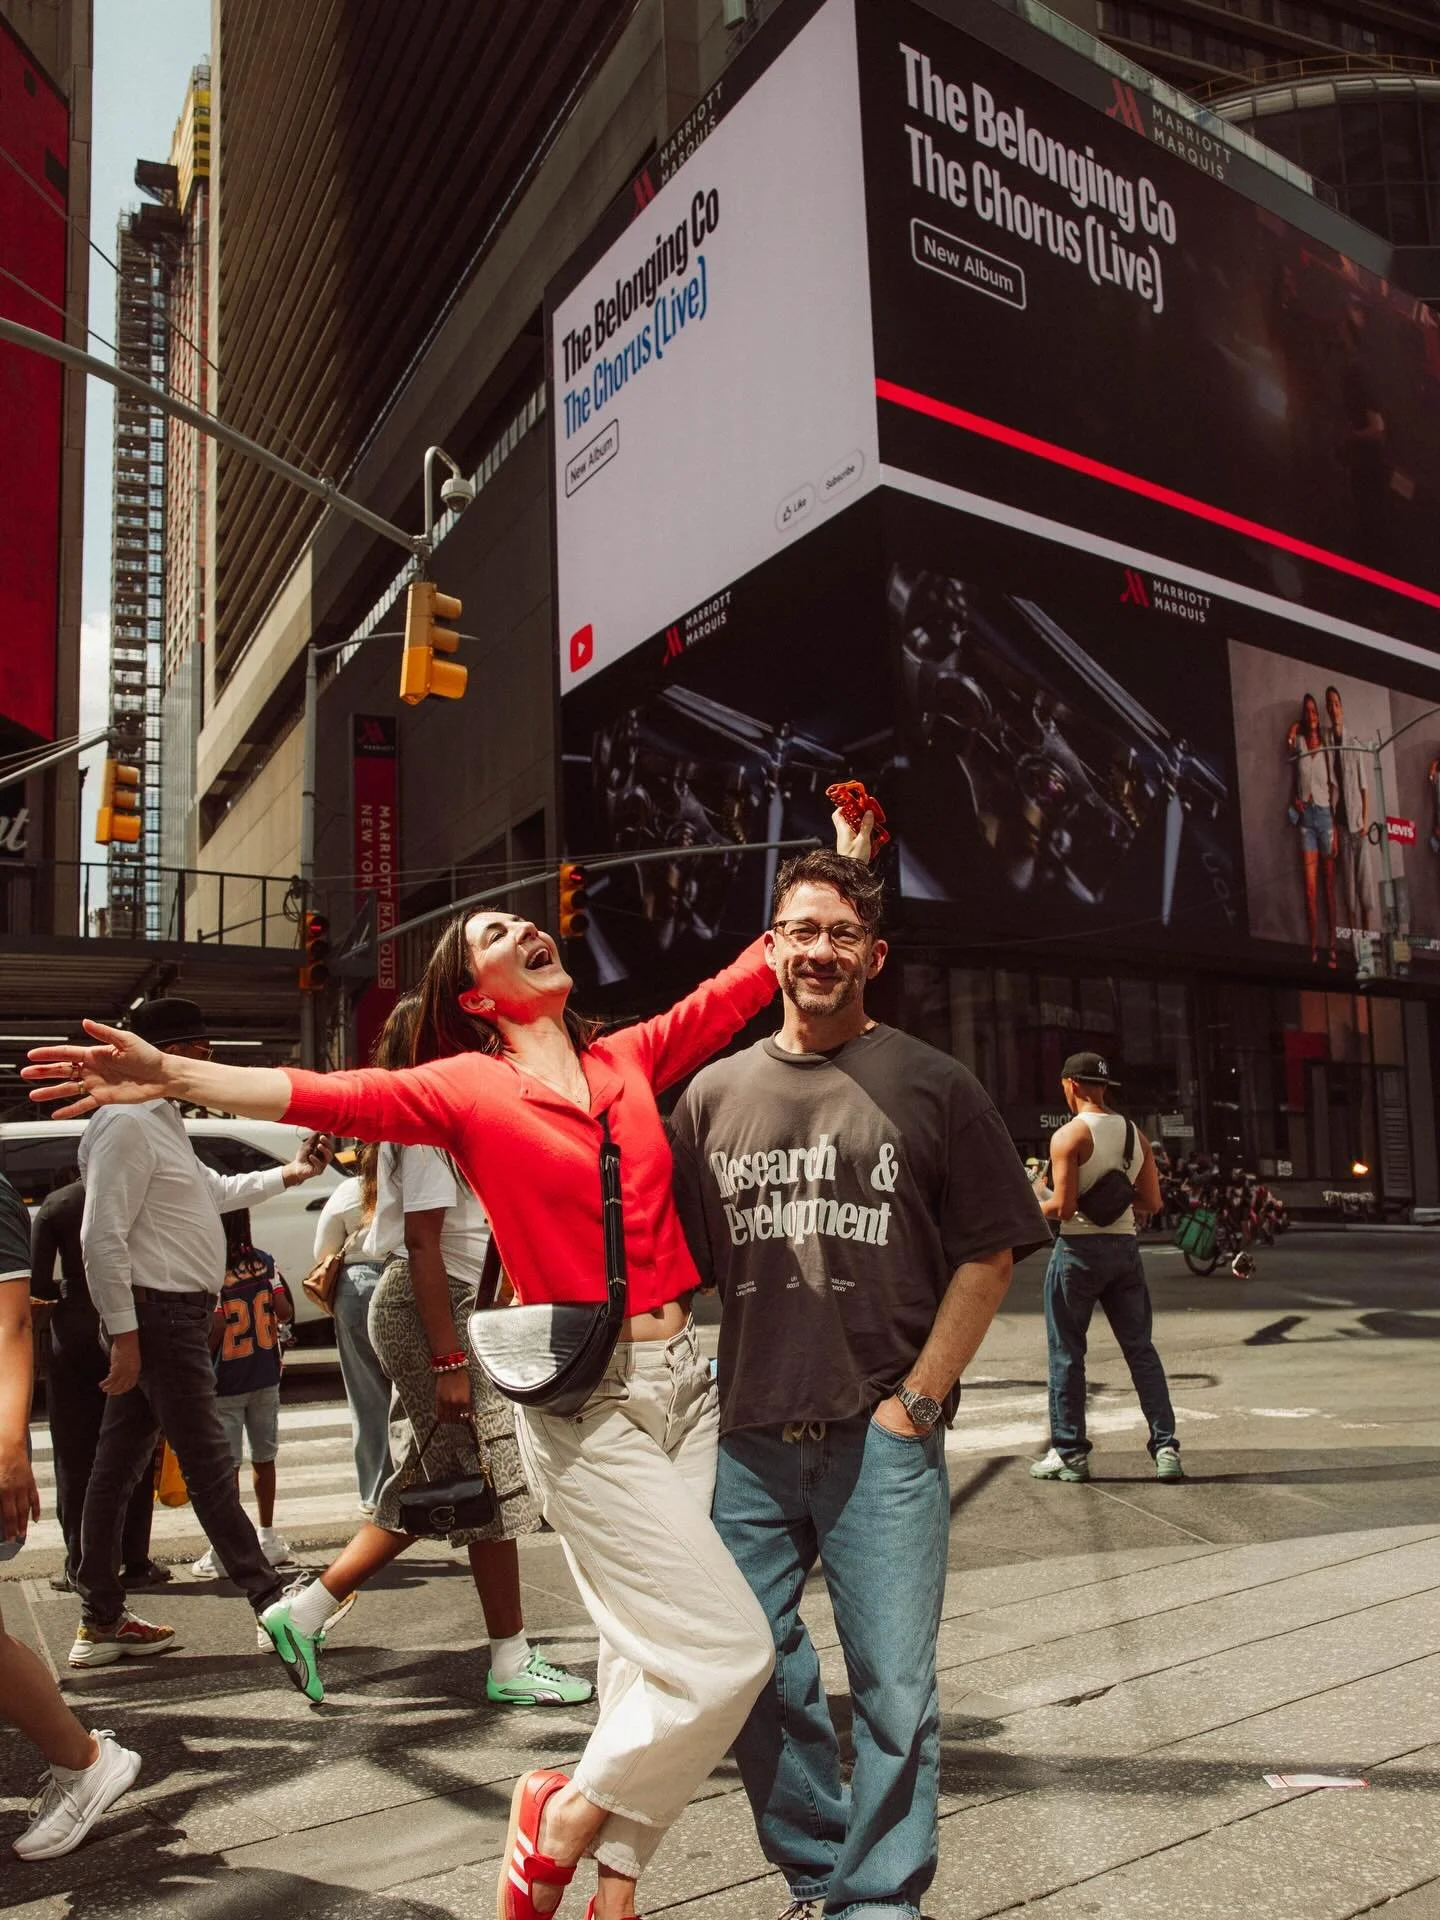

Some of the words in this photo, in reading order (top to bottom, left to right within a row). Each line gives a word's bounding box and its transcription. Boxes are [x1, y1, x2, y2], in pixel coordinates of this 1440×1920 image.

[660, 81, 722, 167] MARRIOTT
[899, 42, 968, 133] The
[972, 82, 1136, 234] Belonging
[1138, 176, 1177, 245] Co
[1152, 104, 1231, 164] MARRIOTT
[1154, 127, 1225, 181] MARQUIS
[904, 123, 967, 208] The
[972, 160, 1082, 264] Chorus
[1085, 215, 1164, 314] (Live)
[562, 324, 592, 384] The
[594, 234, 689, 352] Belonging
[691, 188, 719, 248] Co
[923, 235, 961, 268] New
[963, 254, 1015, 293] Album
[563, 389, 592, 440] The
[593, 324, 652, 412] Chorus
[654, 255, 708, 360] (Live)
[569, 462, 588, 484] New
[588, 437, 614, 466] Album
[825, 464, 856, 490] Subscribe
[793, 497, 807, 513] Like
[685, 591, 732, 631] MARRIOTT
[1153, 579, 1211, 609] MARRIOTT
[1155, 596, 1207, 623] MARQUIS
[686, 611, 727, 647] MARQUIS
[361, 804, 373, 843] NEW
[380, 805, 392, 898] MARRIOTT
[361, 850, 374, 891] YOR
[380, 904, 393, 986] MAQUIS
[710, 1133, 837, 1199] Research
[870, 1142, 899, 1193] &
[222, 1290, 278, 1361] 26
